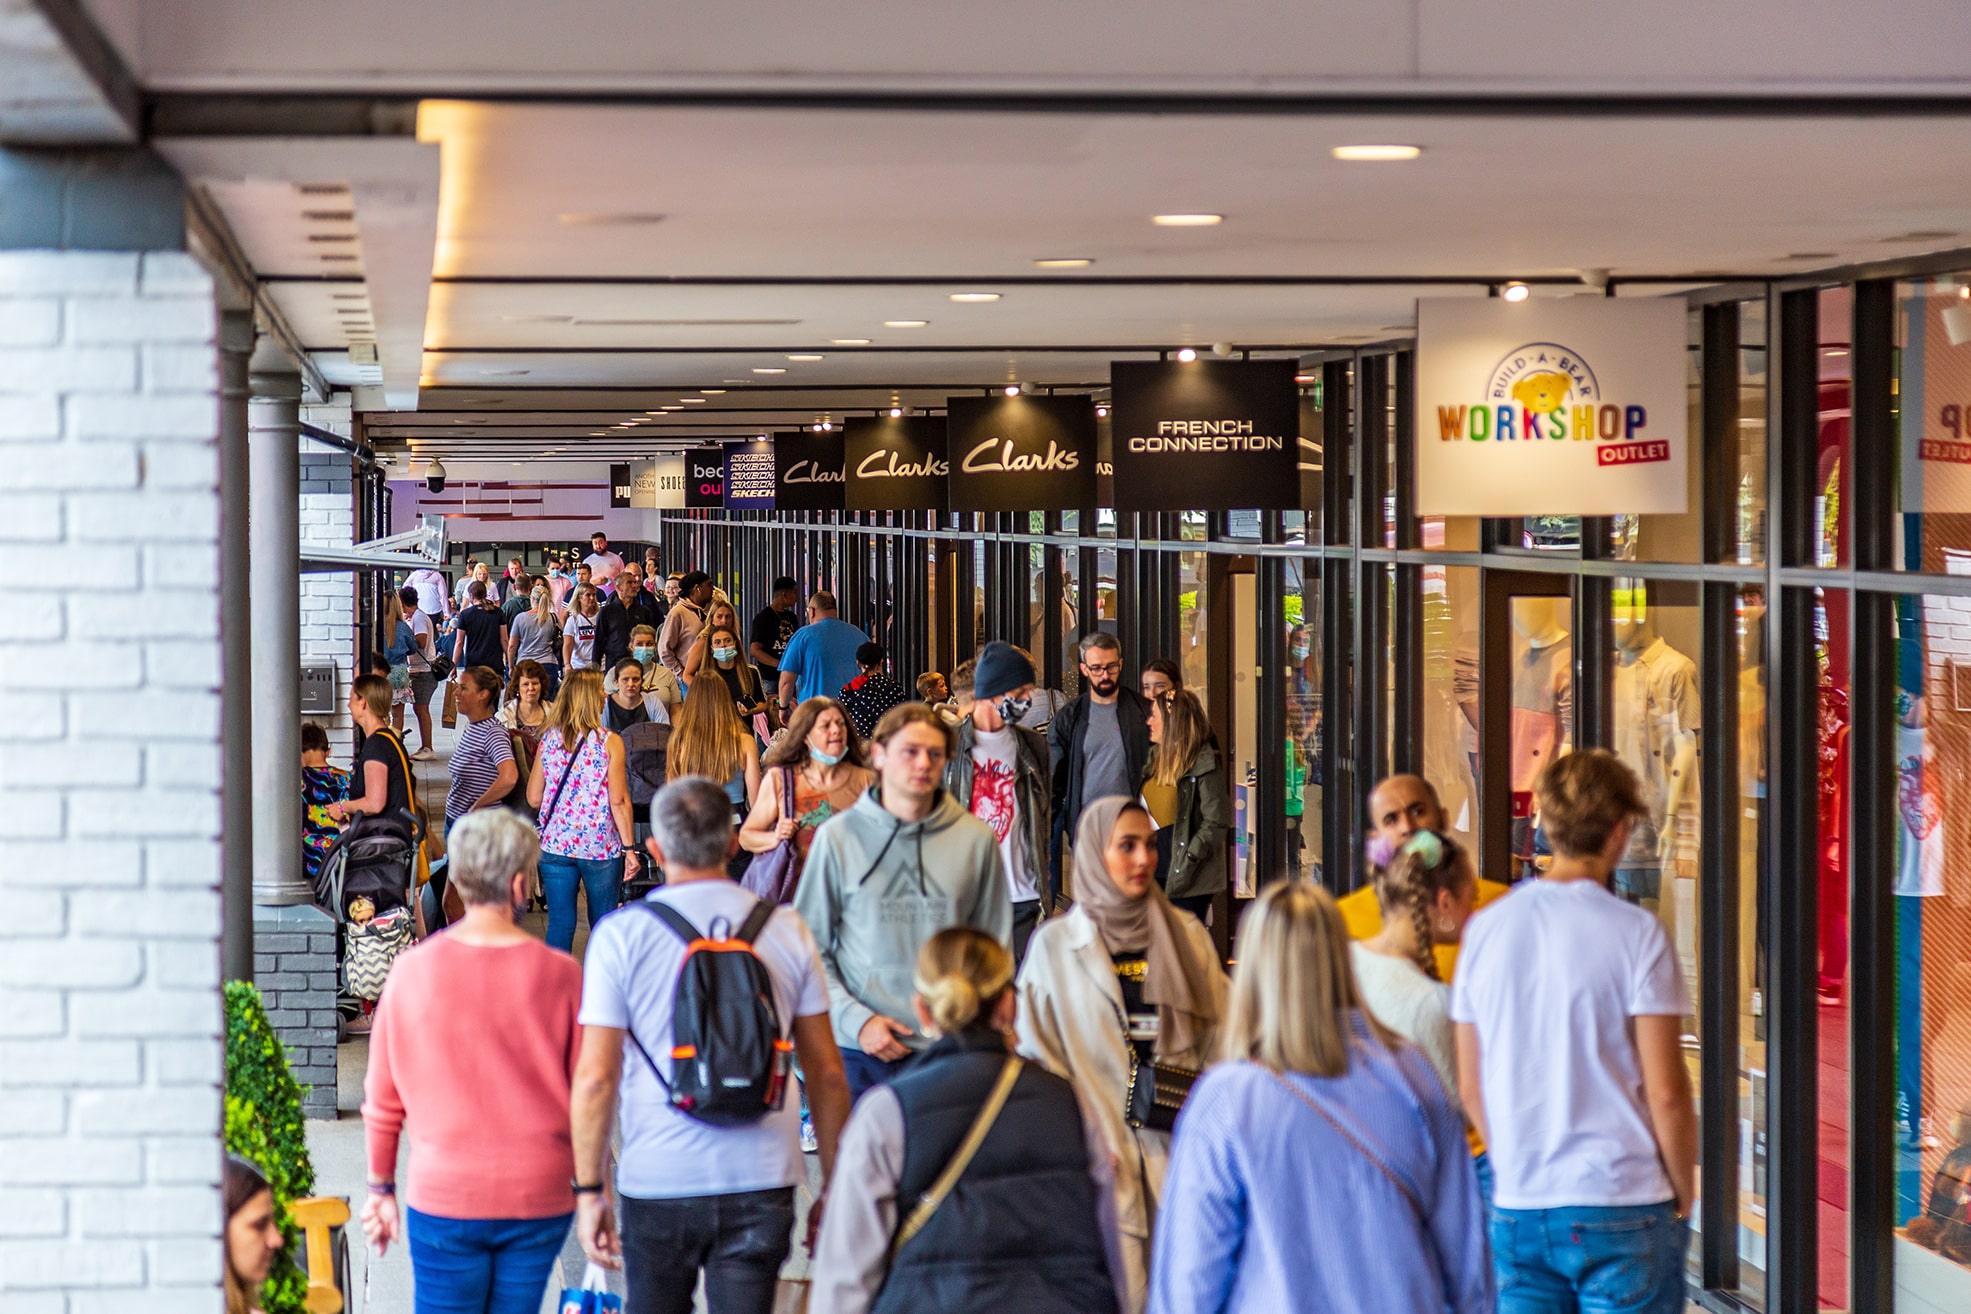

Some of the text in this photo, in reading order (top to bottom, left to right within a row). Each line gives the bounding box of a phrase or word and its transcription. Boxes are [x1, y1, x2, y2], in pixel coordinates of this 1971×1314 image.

[1158, 420, 1253, 435] FRENCH
[1438, 404, 1647, 441] WORKSHOP
[962, 437, 1079, 473] Clarks
[1129, 436, 1283, 452] CONNECTION
[1600, 443, 1667, 463] OUTLET
[856, 449, 949, 478] Clarks
